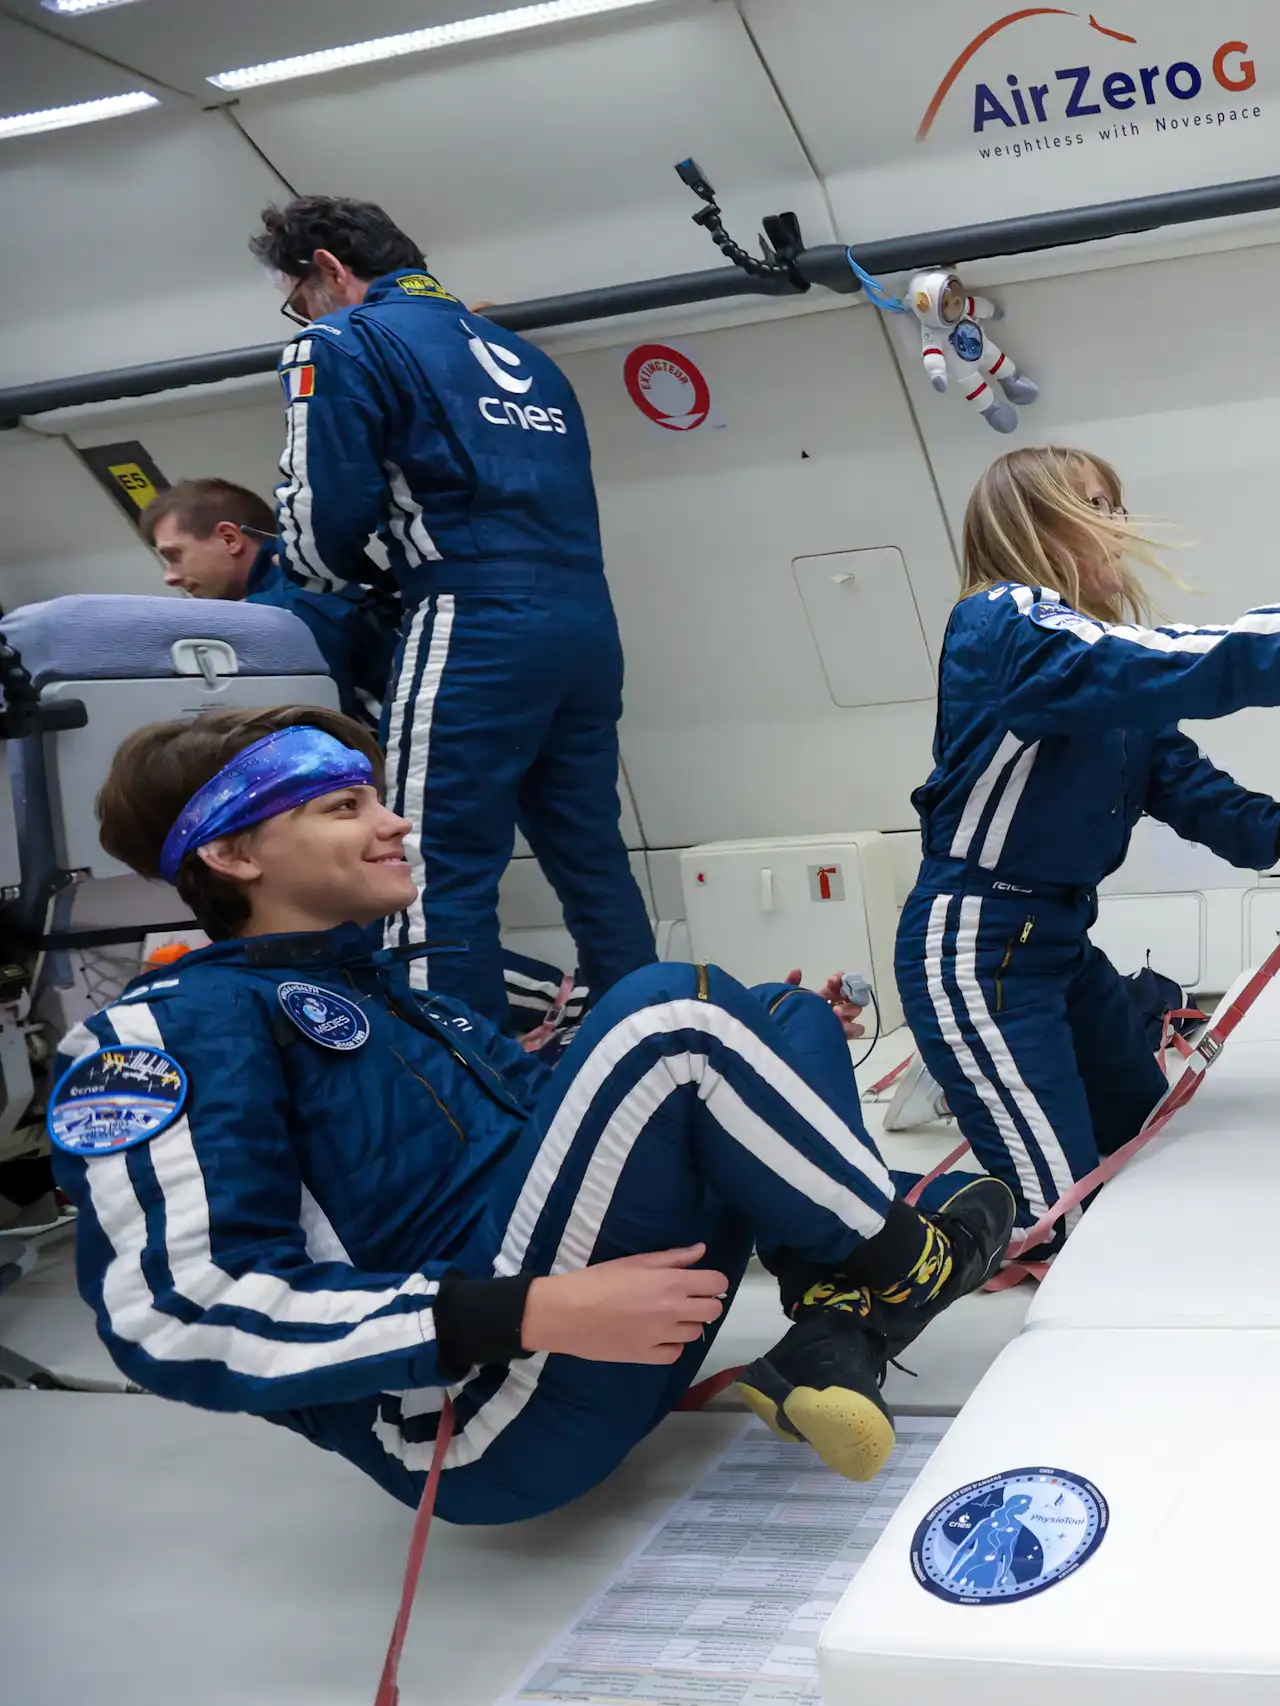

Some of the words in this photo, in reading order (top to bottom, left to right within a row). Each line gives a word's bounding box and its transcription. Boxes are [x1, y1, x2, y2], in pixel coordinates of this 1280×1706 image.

[1212, 41, 1257, 92] G
[979, 131, 1084, 159] weightless
[1099, 123, 1140, 141] with
[1155, 104, 1261, 132] Novespace
[640, 361, 689, 391] EXTINCTEUR
[478, 396, 567, 434] cnes
[117, 472, 147, 490] E5
[313, 1014, 350, 1034] MEDES
[1030, 1513, 1086, 1526] PhysioTool
